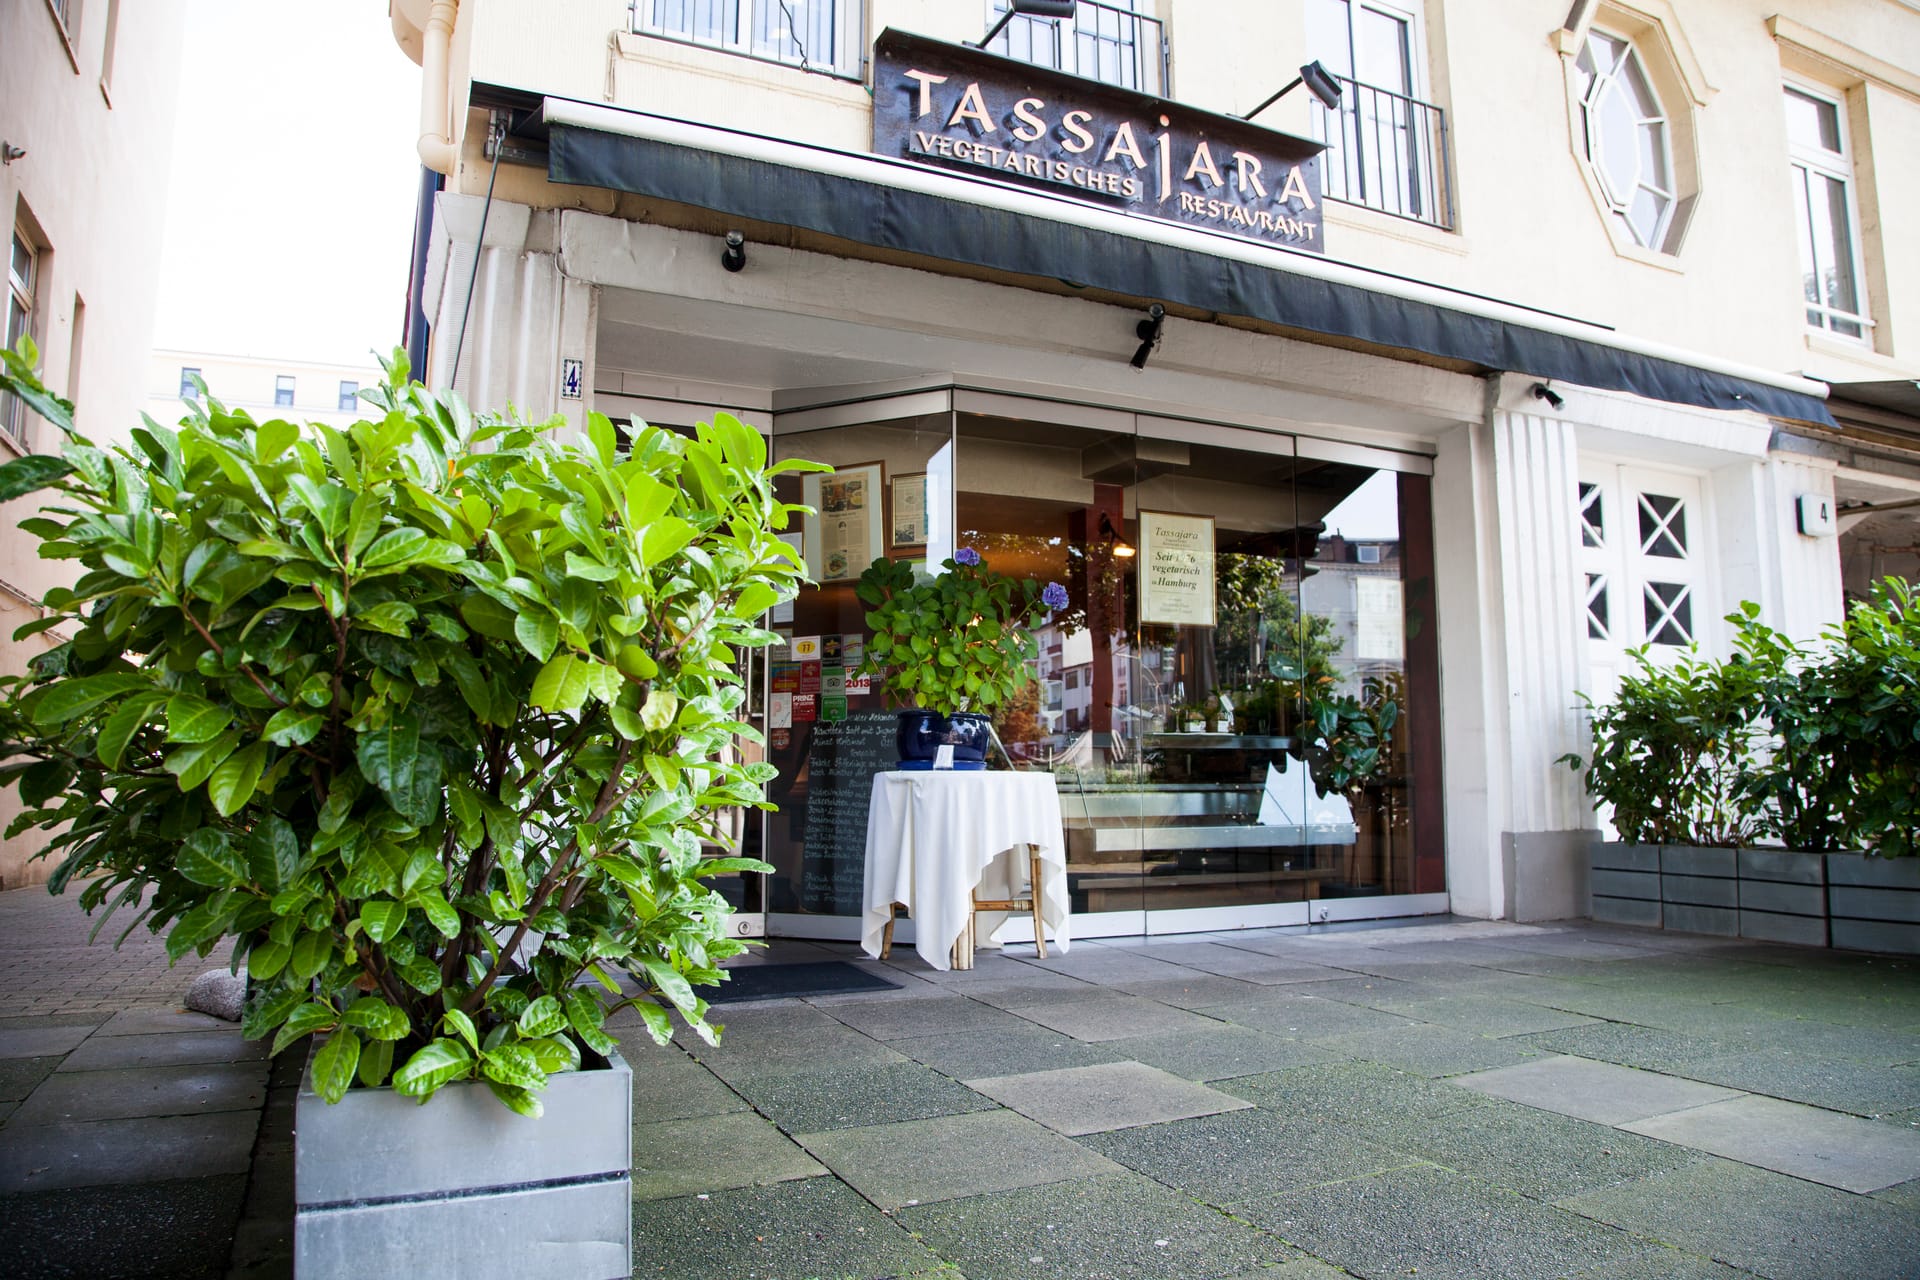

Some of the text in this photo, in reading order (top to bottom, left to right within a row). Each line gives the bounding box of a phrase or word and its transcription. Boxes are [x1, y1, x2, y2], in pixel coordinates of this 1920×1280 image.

[915, 130, 1137, 198] VEGETARISCHES
[1179, 191, 1316, 241] RESTAURANT
[566, 365, 579, 393] 4
[1821, 502, 1828, 523] 4
[1155, 527, 1199, 541] Tassajara
[1155, 551, 1173, 561] Seit
[1152, 564, 1201, 575] vegetarisch
[1157, 577, 1197, 590] Hamburg
[845, 678, 870, 688] 2013
